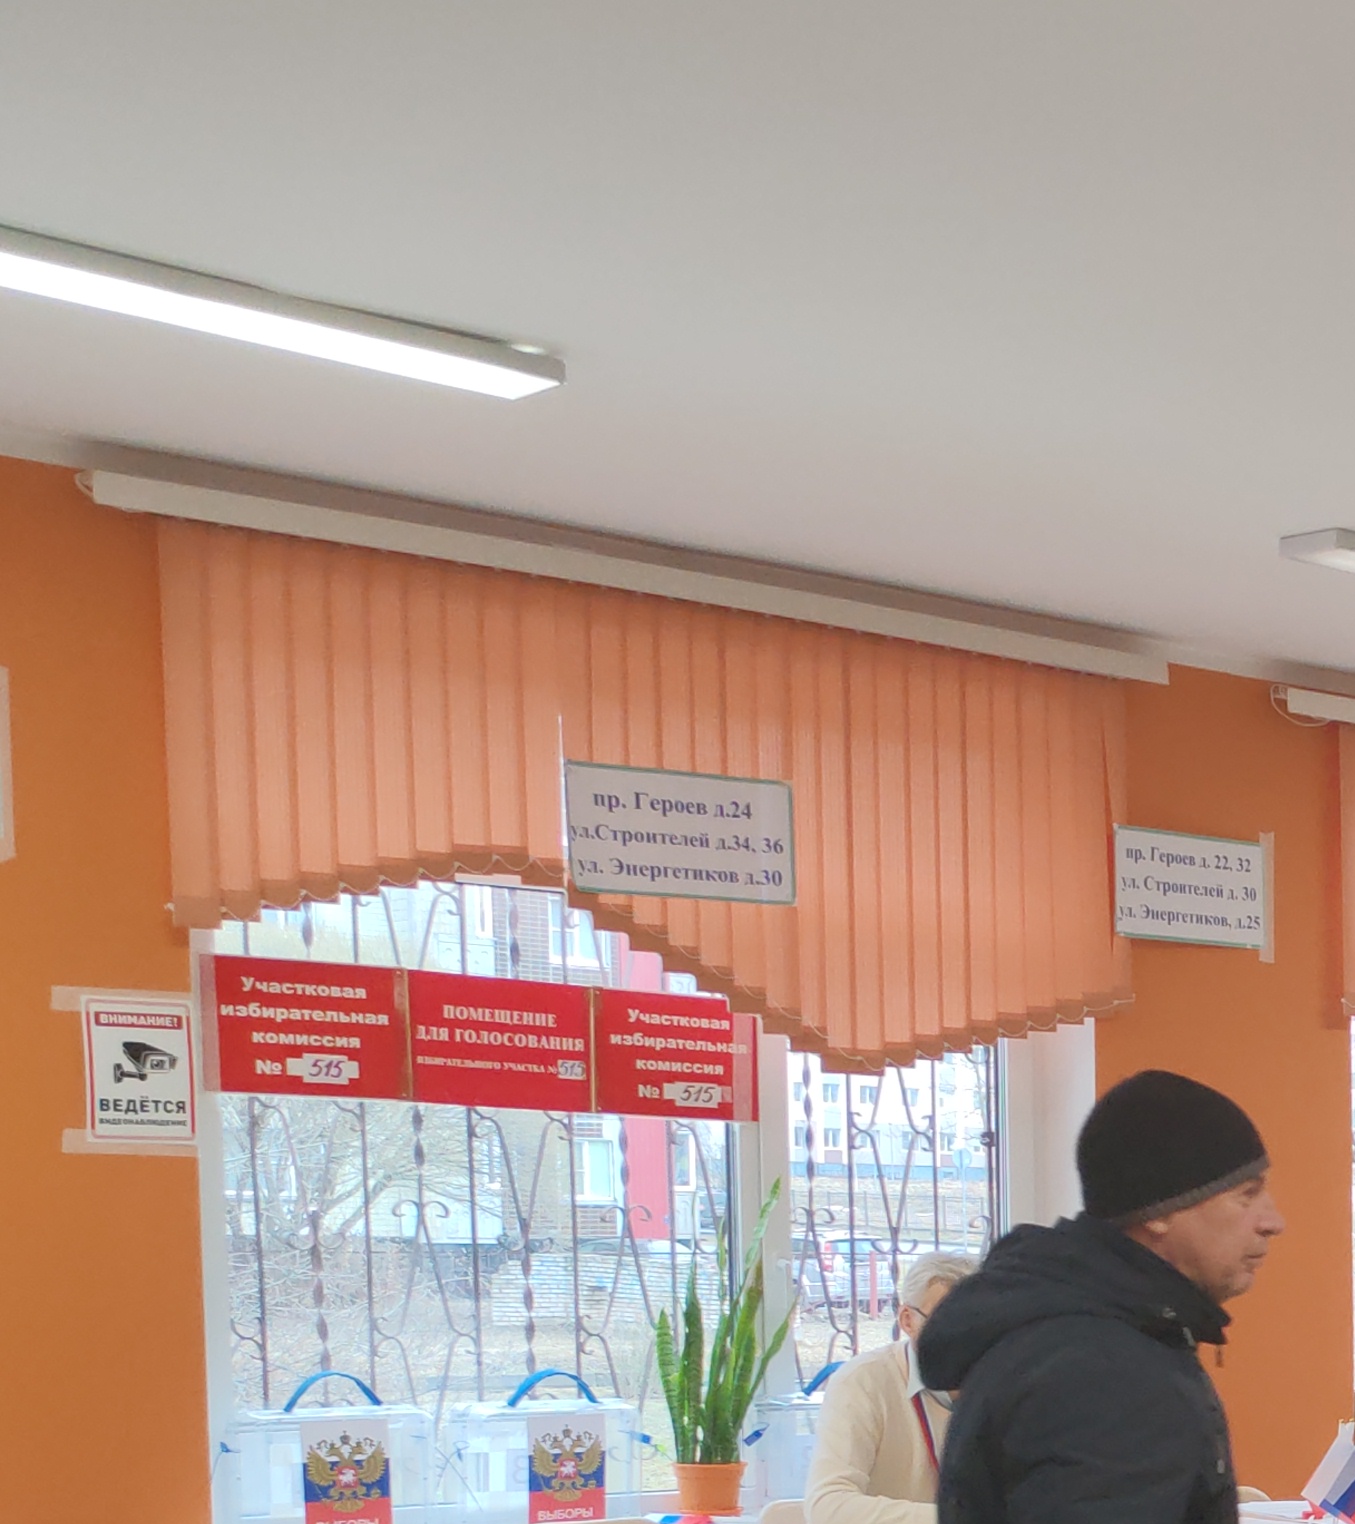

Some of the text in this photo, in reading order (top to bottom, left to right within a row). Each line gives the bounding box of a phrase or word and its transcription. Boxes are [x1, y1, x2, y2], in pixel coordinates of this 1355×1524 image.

[593, 791, 752, 820] пр. Героев д.24
[761, 837, 784, 854] 36
[1126, 846, 1252, 872] пр. Героев д. 22, 32
[577, 857, 783, 887] ул. Энергетиков д.30
[1121, 875, 1257, 902] ул. Строителей д. 30
[1118, 903, 1261, 930] ул. Энергетиков, д.25
[240, 976, 367, 999] Участковая
[99, 1013, 179, 1028] ВНИМАНИЕ!
[220, 1003, 390, 1026] избирательная
[443, 1004, 557, 1028] ПОМЕЩЕНИЕ
[627, 1008, 731, 1030] Участковая
[252, 1031, 361, 1049] комиссия
[416, 1025, 585, 1052] ДЛЯ ГОЛОСОВАНИЯ
[609, 1033, 748, 1054] избирательная
[255, 1059, 347, 1078] № 515
[635, 1059, 724, 1075] комиссия
[637, 1084, 716, 1103] № 515
[99, 1095, 187, 1115] ВЕДЁТСЯ
[537, 1506, 594, 1522] ВЫБОРЫ
